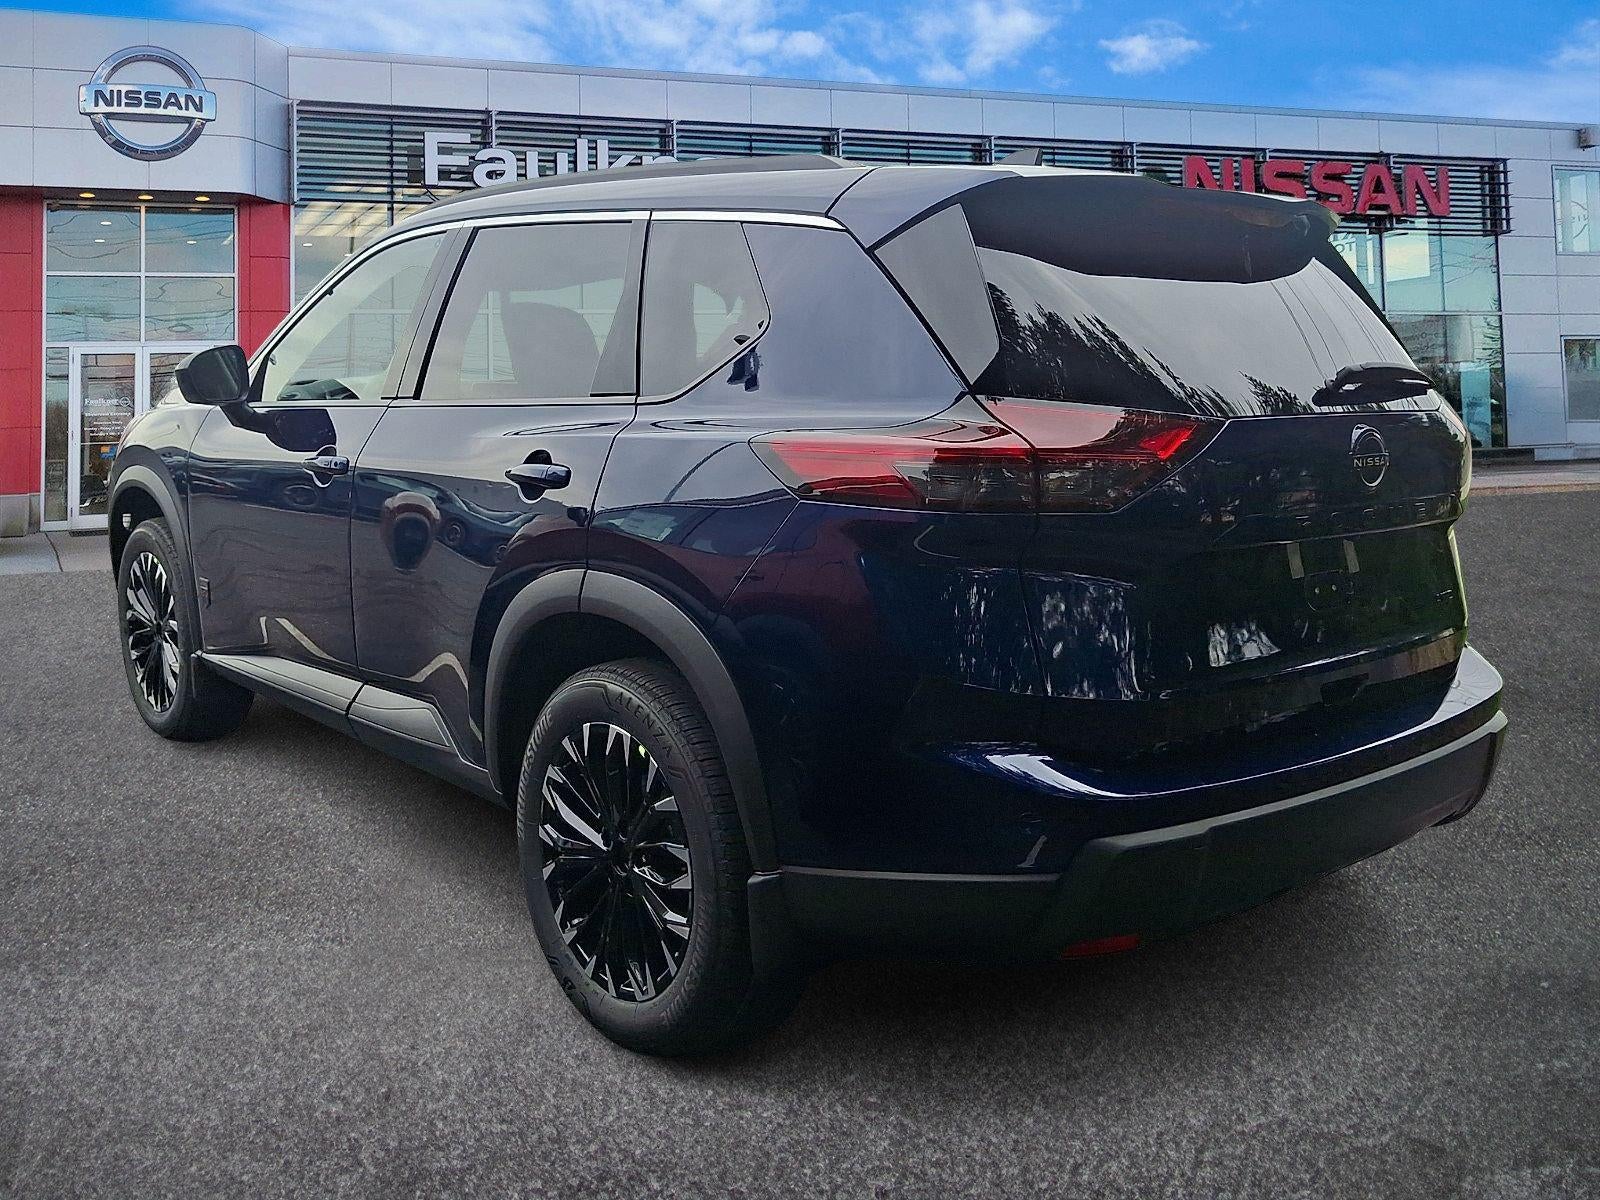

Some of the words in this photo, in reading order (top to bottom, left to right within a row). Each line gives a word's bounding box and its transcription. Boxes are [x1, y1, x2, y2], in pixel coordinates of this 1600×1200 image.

[94, 89, 203, 113] NISSAN
[1354, 456, 1390, 467] NISSA
[615, 692, 672, 757] ALENZA
